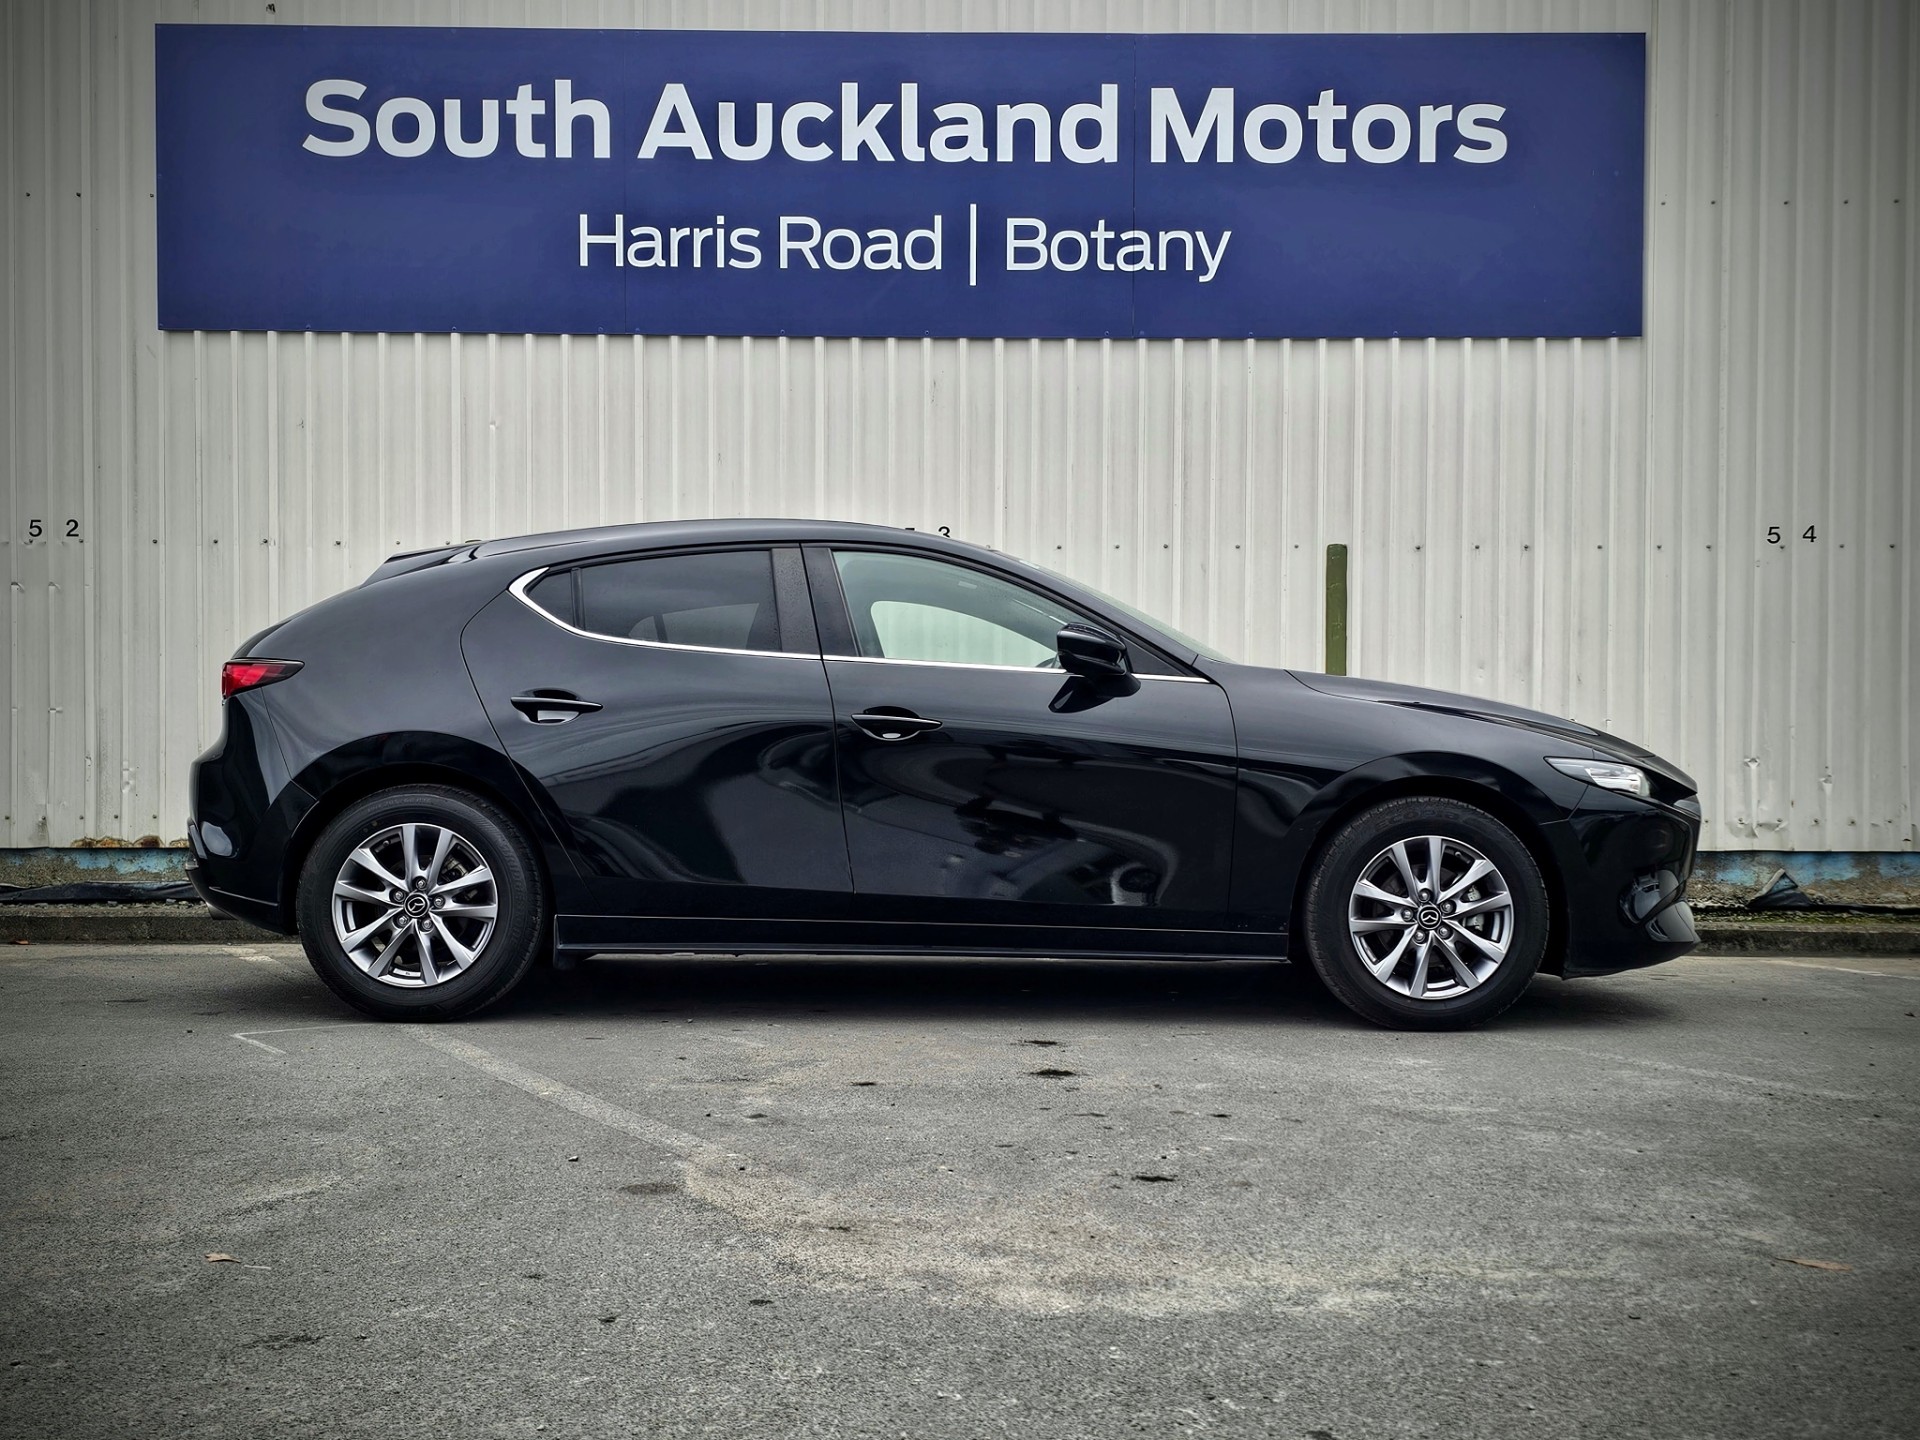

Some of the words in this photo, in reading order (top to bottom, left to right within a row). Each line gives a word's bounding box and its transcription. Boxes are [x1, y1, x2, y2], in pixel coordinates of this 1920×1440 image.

[302, 79, 611, 160] South
[637, 82, 1119, 164] Auckland
[1150, 87, 1508, 164] Motors
[579, 213, 762, 270] Harris
[779, 214, 943, 271] Road
[1005, 217, 1232, 283] Botany
